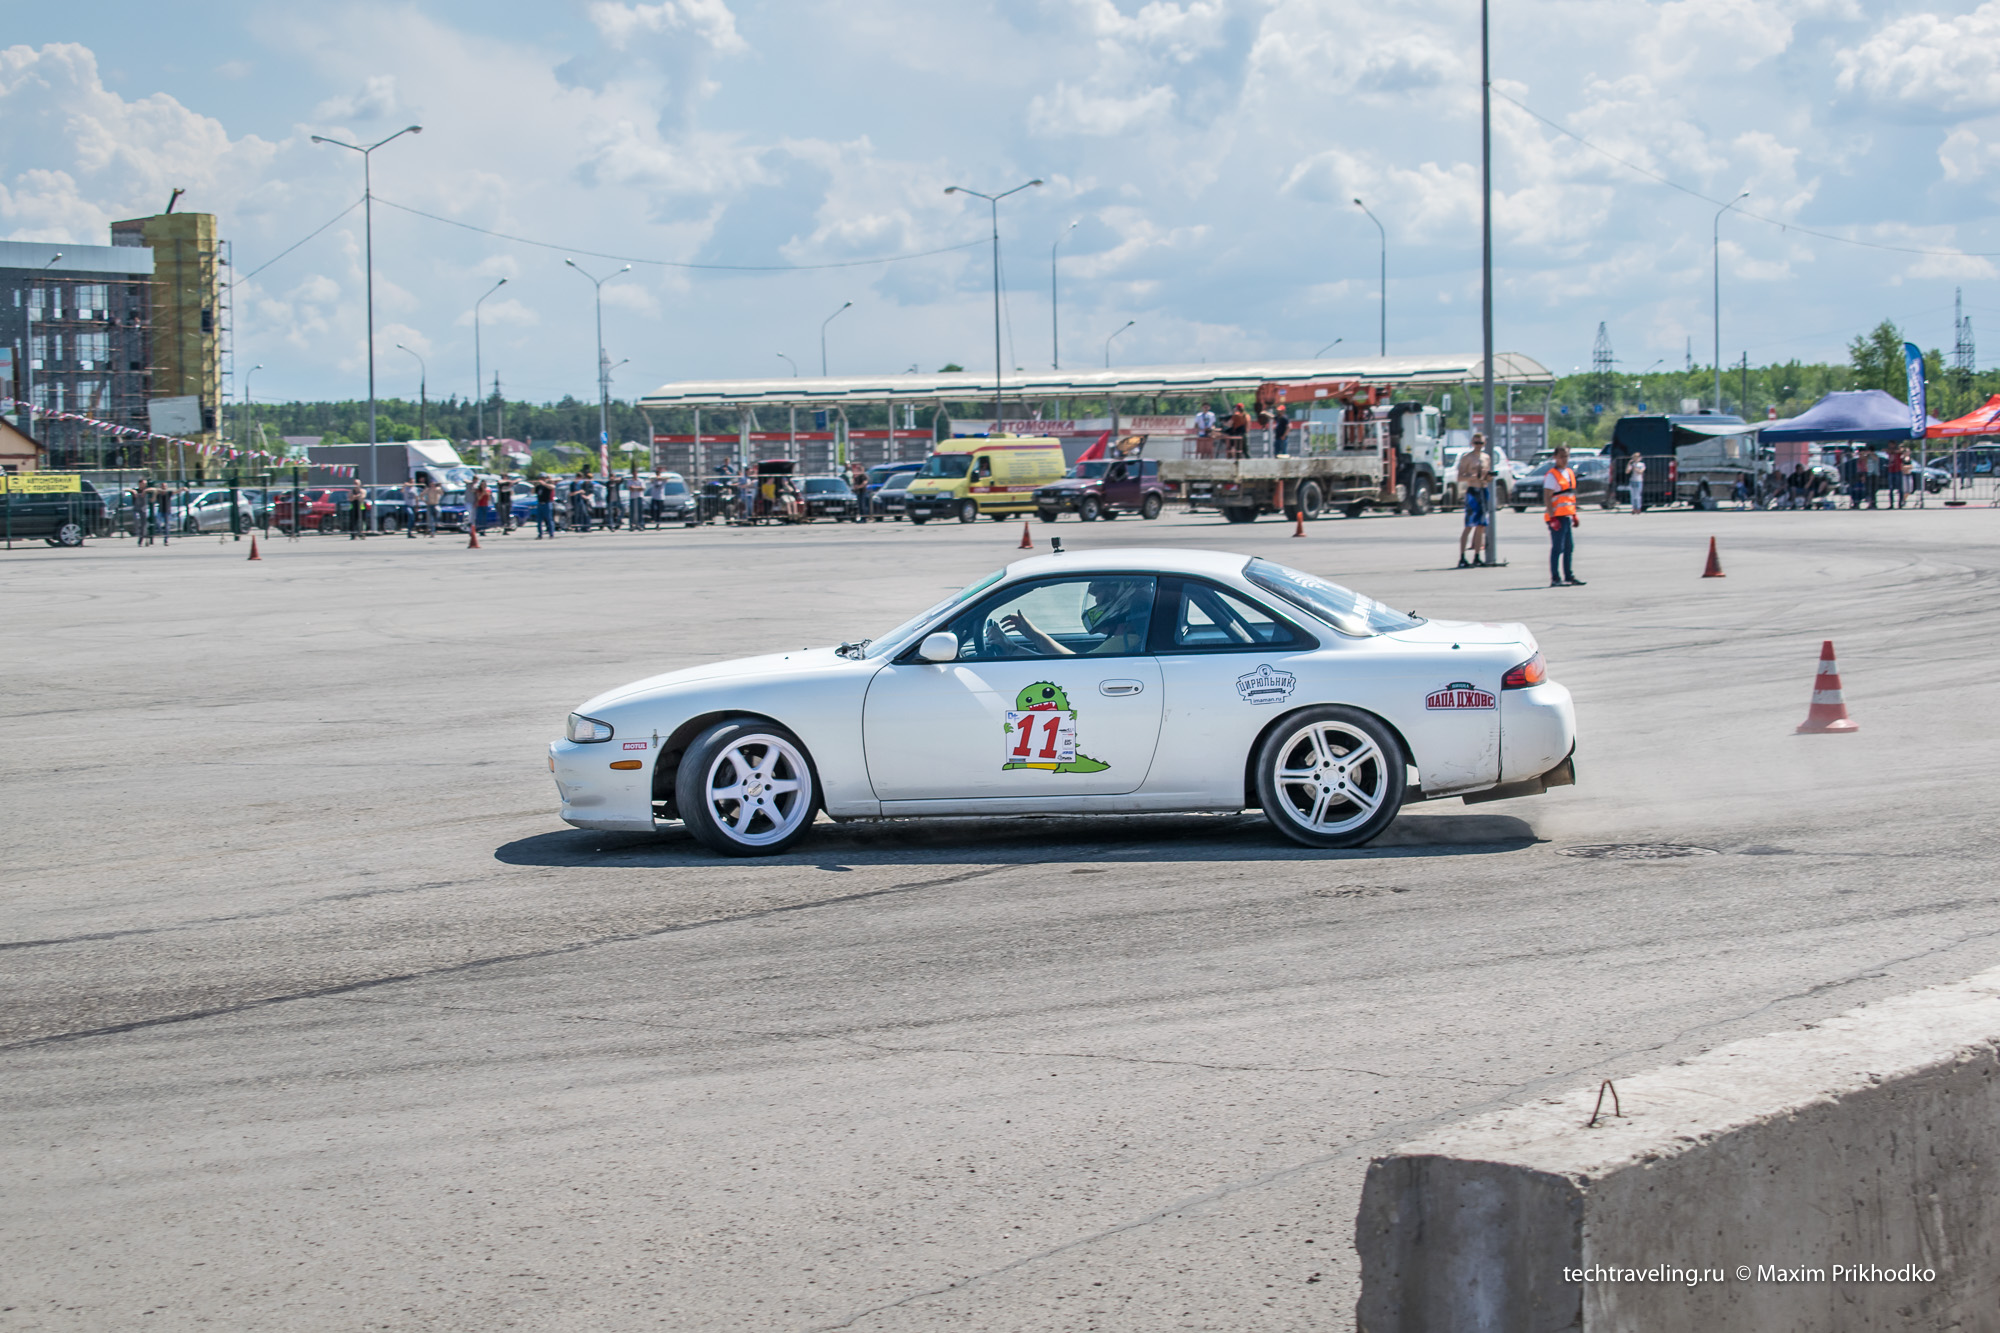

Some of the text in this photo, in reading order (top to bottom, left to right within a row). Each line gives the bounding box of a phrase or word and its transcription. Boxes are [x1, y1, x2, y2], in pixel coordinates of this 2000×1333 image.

[1239, 677, 1294, 692] ЦИРЮЛЬНИК
[1427, 691, 1494, 708] ПАПА ДЖОНС
[1013, 714, 1061, 759] 11
